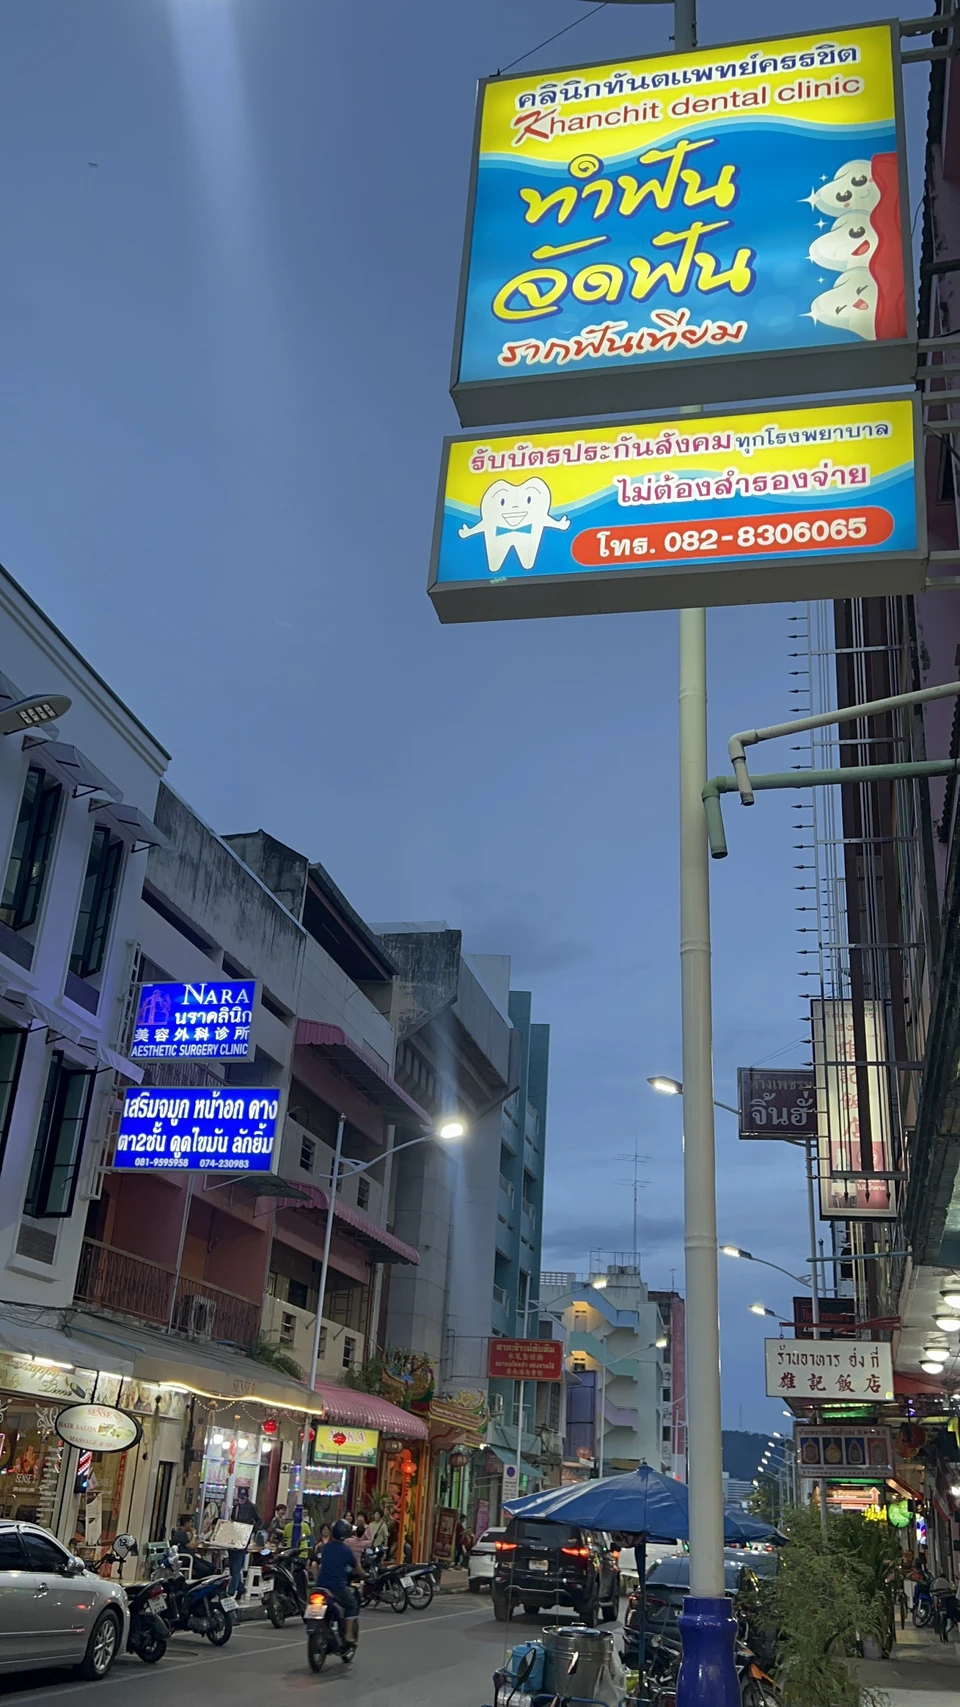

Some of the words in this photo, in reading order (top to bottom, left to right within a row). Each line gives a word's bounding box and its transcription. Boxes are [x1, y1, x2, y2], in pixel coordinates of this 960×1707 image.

[518, 44, 858, 109] คลินิกทันตแพทย์ครรชิต
[514, 103, 660, 145] Khanchit
[671, 86, 767, 117] dental
[778, 76, 861, 103] clinic
[519, 138, 736, 226] ทำฟัน
[493, 220, 753, 321] จัดฟัน
[501, 311, 744, 365] รากฟันเทียม
[471, 432, 731, 472] รับบัตรประกันสังคม
[735, 422, 889, 455] ทุกโรงพยาบาล
[617, 464, 868, 505] ไม่ต้องสำรองจ่าย
[596, 531, 656, 558] โทร.
[664, 517, 868, 552] 082-8306065
[181, 983, 250, 1005] NARA
[174, 1006, 252, 1025] นราคลินิก
[131, 1045, 177, 1057] AESTHETIC
[178, 1043, 219, 1056] SURGERY
[220, 1043, 249, 1055] CLINIC
[133, 1025, 250, 1042] 美容外科诊所
[123, 1091, 190, 1126] เสริมจมูก
[193, 1091, 244, 1119] หน้าอก
[249, 1099, 278, 1120] คาง
[118, 1121, 167, 1152] ตา2ชั้น
[170, 1127, 228, 1159] ดูดไขมัน
[231, 1123, 274, 1154] ลักยิ้ม
[777, 1345, 840, 1367] ร้านอาหาร
[778, 1371, 882, 1393] 雄記飯店
[58, 1421, 73, 1429] HAIR
[75, 1424, 97, 1433] SALON
[87, 1408, 112, 1418] SENSE
[69, 1436, 97, 1445] MASSAGE
